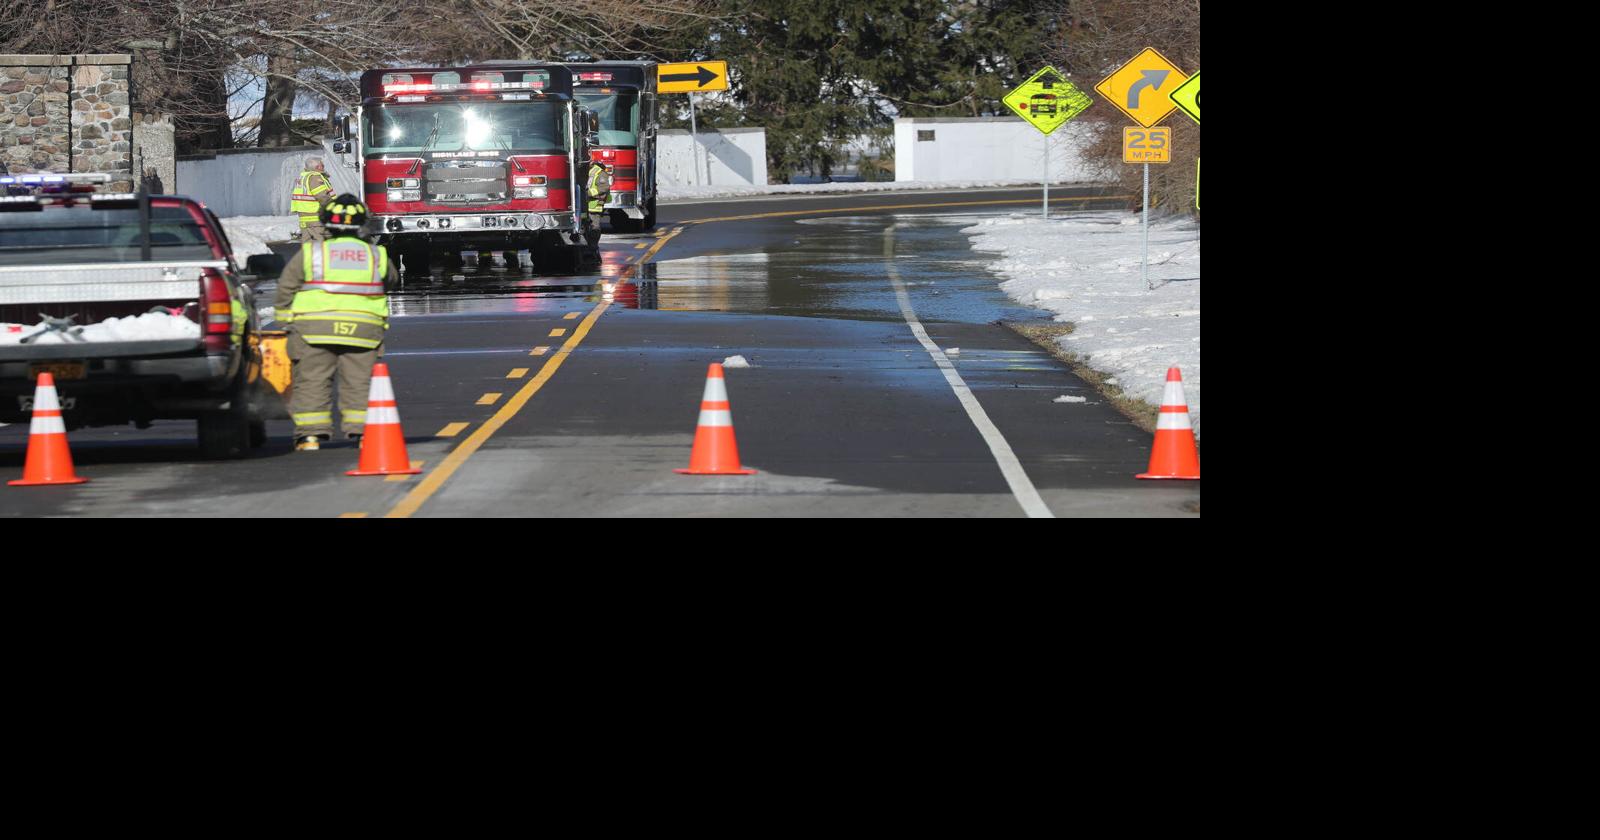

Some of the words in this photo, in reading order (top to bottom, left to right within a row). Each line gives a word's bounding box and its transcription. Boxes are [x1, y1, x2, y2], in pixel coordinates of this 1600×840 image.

[1127, 131, 1166, 149] 25
[330, 249, 366, 262] FIRE
[333, 321, 358, 335] 157
